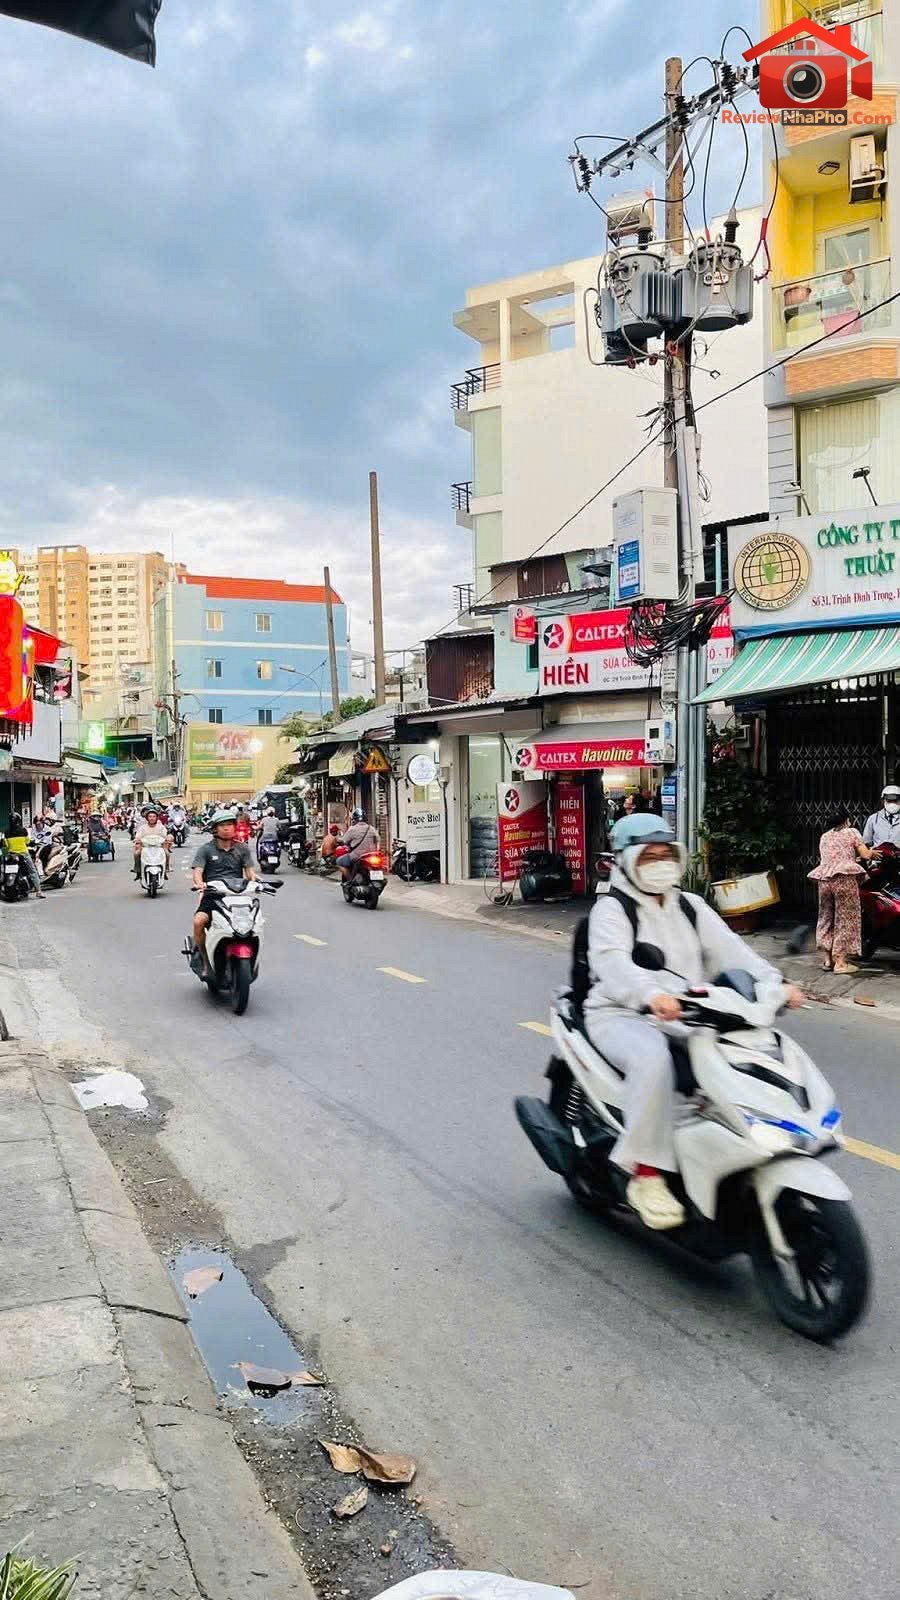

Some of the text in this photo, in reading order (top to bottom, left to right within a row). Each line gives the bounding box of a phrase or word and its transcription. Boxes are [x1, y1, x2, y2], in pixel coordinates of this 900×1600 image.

[741, 535, 799, 559] INTERNATIONAL
[817, 522, 859, 549] CÔNG
[863, 522, 885, 543] TY
[844, 547, 896, 577] THUẬT
[739, 577, 806, 609] TECHNICAL COMPANY
[575, 624, 625, 642] CALTEX
[543, 656, 589, 686] HIỀN
[539, 752, 577, 764] CALTEX
[581, 746, 634, 762] Havoline
